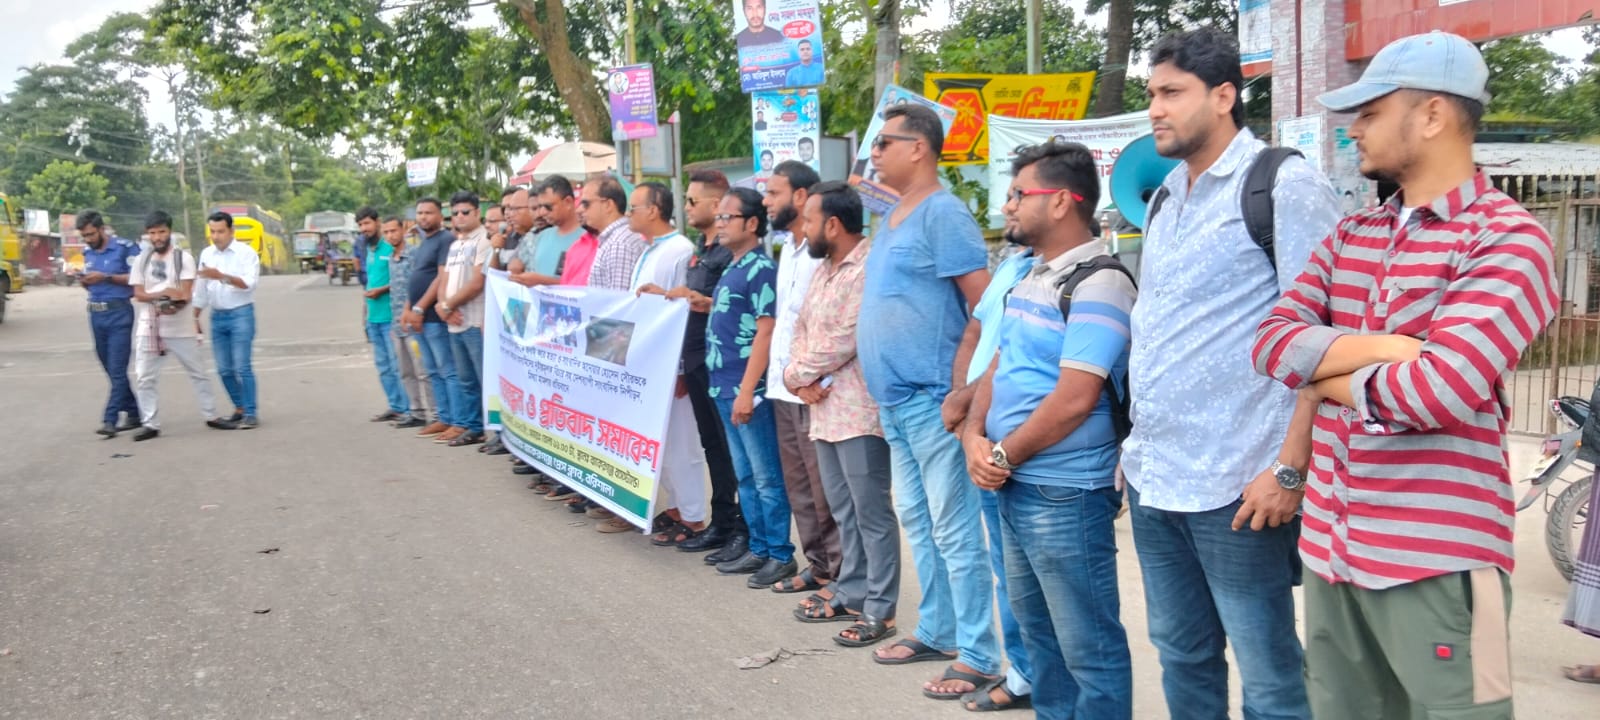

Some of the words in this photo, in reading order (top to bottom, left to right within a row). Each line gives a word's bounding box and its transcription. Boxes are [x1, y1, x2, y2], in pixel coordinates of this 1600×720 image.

[526, 393, 537, 419] ও
[539, 393, 596, 443] প্রতিবাদ
[597, 418, 661, 473] সমাবেশ
